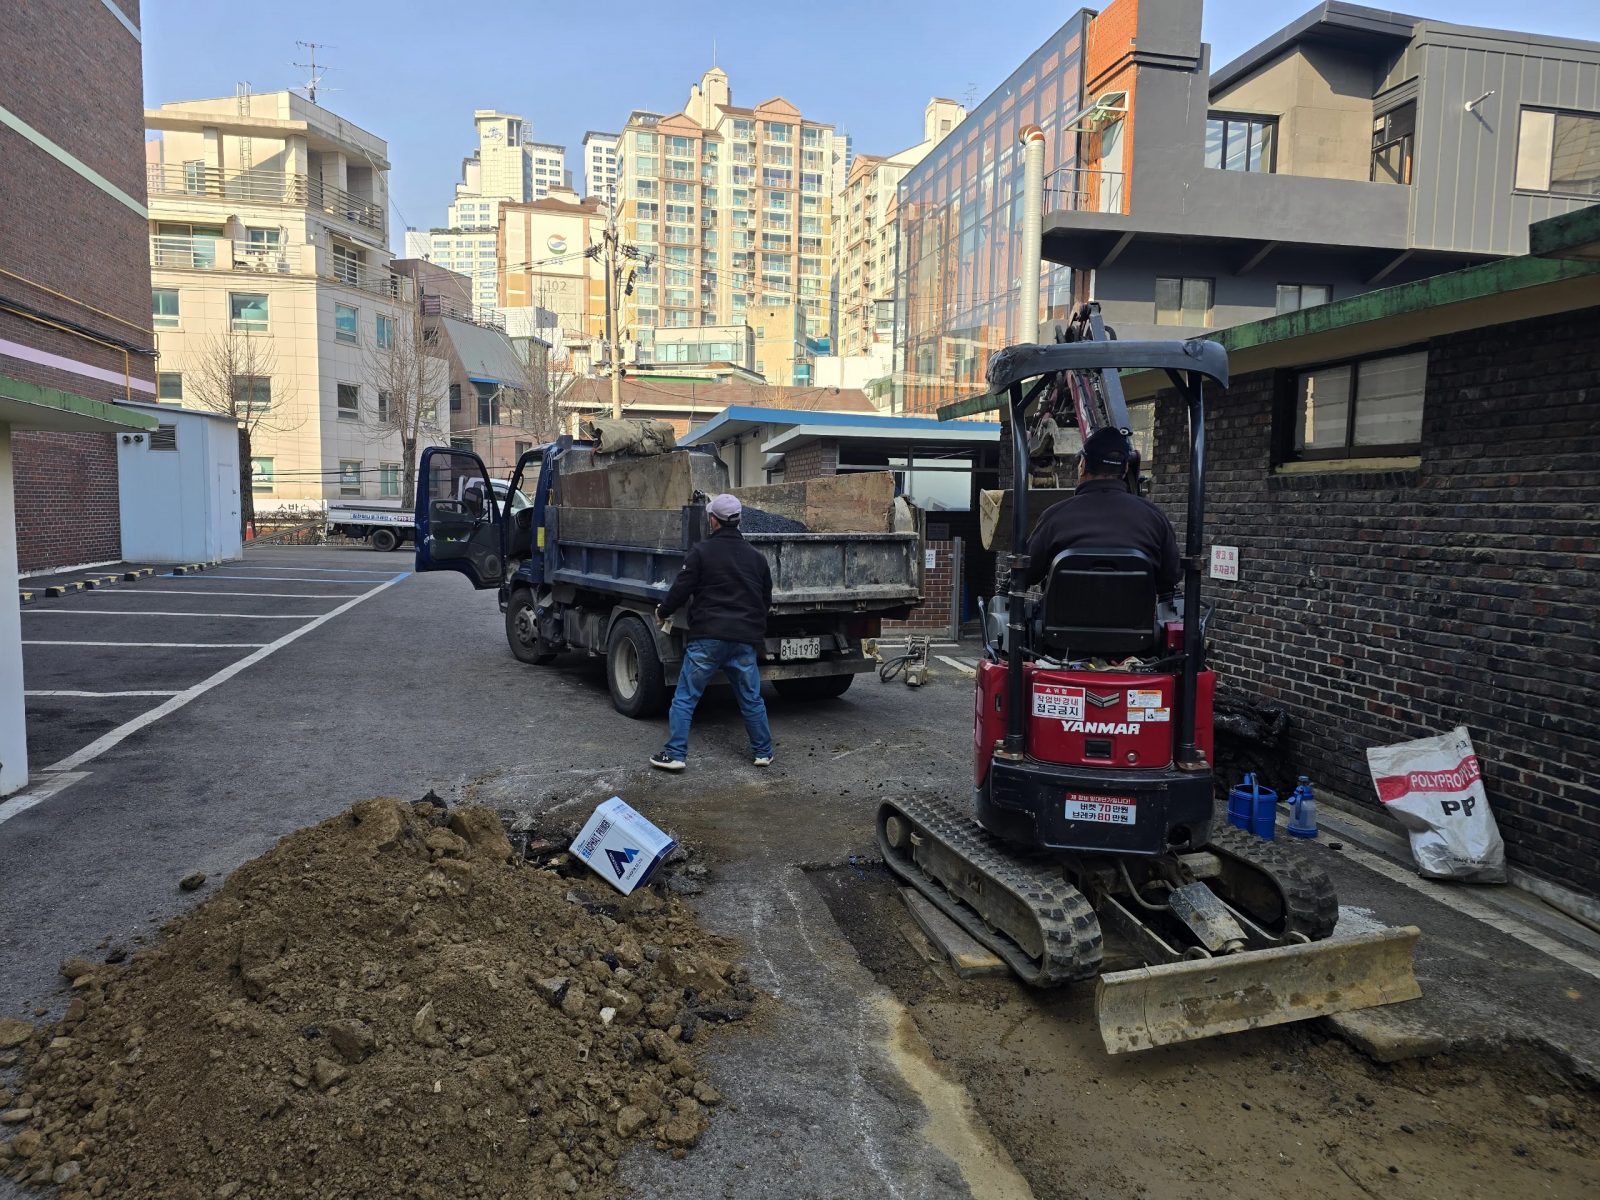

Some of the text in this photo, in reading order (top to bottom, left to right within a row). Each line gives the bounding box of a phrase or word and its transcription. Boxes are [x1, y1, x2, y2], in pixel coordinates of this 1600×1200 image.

[546, 280, 567, 292] 102
[1036, 703, 1079, 716] 접근금지
[1061, 720, 1141, 735] YANMAR
[1410, 759, 1480, 788] POLYPROPYLE
[1441, 795, 1476, 817] PP
